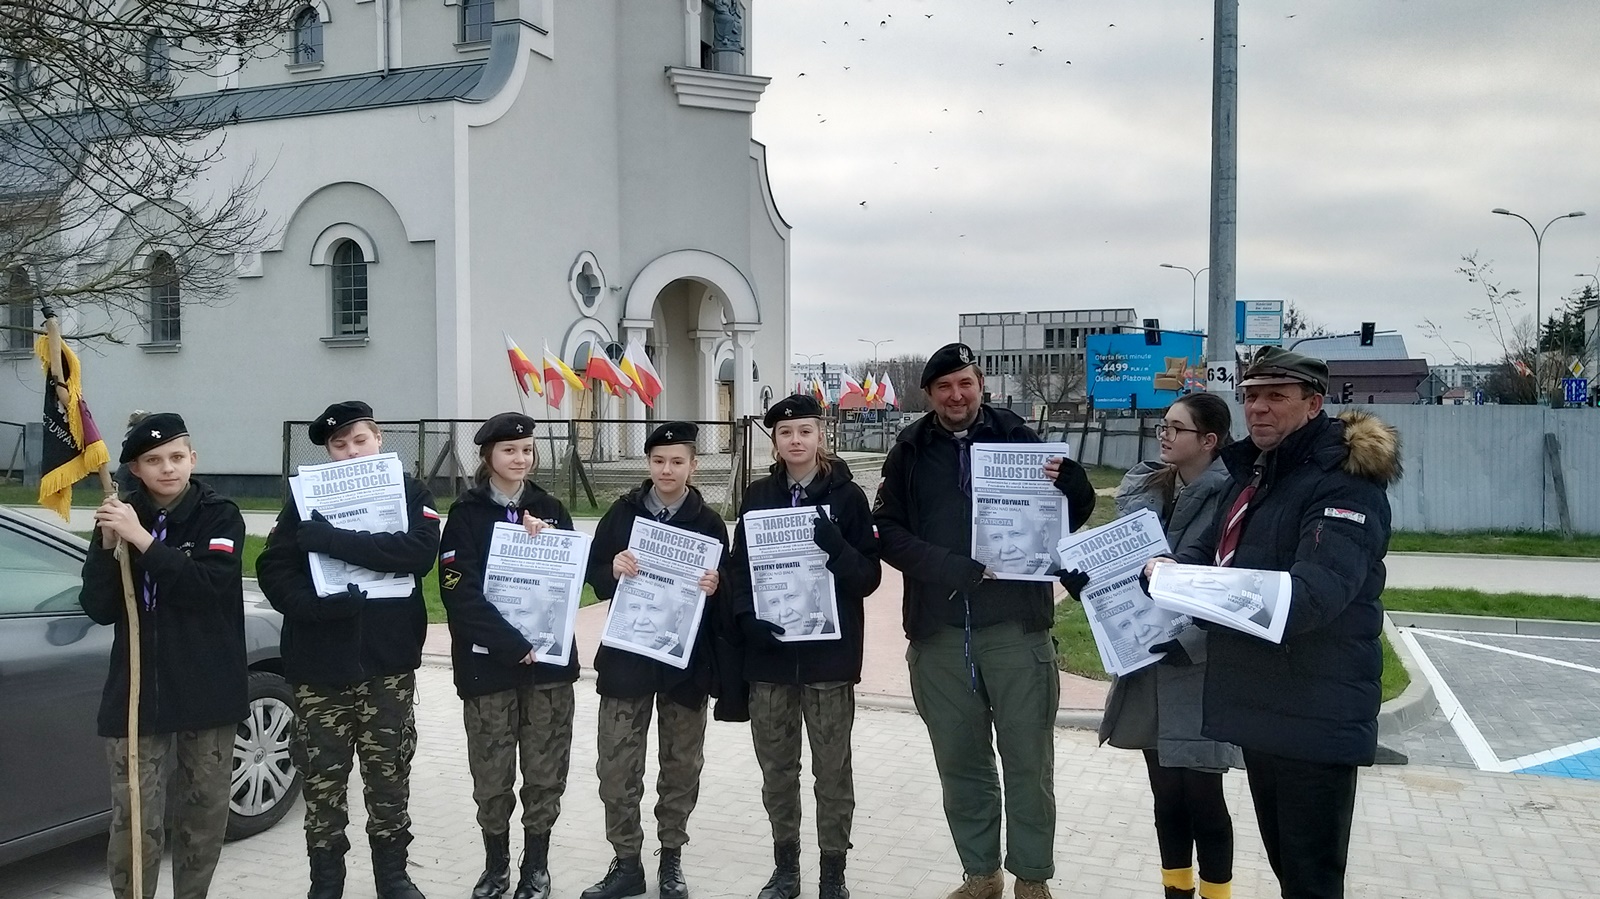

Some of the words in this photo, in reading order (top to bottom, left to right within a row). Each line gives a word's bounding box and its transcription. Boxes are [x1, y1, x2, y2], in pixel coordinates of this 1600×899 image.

[1102, 363, 1128, 372] 4499
[1095, 374, 1120, 382] Osiedle
[994, 452, 1043, 466] HARCERZ
[321, 462, 374, 481] HARCERZ
[984, 465, 1049, 479] BIAŁOSTOC
[313, 473, 390, 495] BIAŁOSTOCKI
[338, 507, 368, 518] OBYWATEL
[763, 514, 807, 530] HARCERZ
[512, 531, 559, 547] HARCERZ
[650, 528, 696, 551] HARCERZ
[756, 527, 813, 545] BIAŁOSTOC
[1080, 524, 1131, 555] HARCERZ
[500, 543, 570, 561] BIAŁOSTOCKI
[639, 537, 705, 567] BIAŁOSTOCKI
[1077, 531, 1151, 572] BIAŁOSTOCKI
[753, 563, 775, 571] WYBITNY
[776, 560, 800, 570] OBYWATEL
[488, 574, 512, 582] WYBITNY
[513, 577, 540, 585] OBYWATEL
[649, 572, 675, 585] OBYWATEL
[623, 586, 653, 599] PATRIOTA
[758, 583, 787, 591] PATRIOTA
[1087, 585, 1112, 600] WYBITNY
[489, 595, 519, 603] PATRIOTA
[1241, 589, 1263, 603] DRUH
[1101, 601, 1132, 619] PATRIOTA
